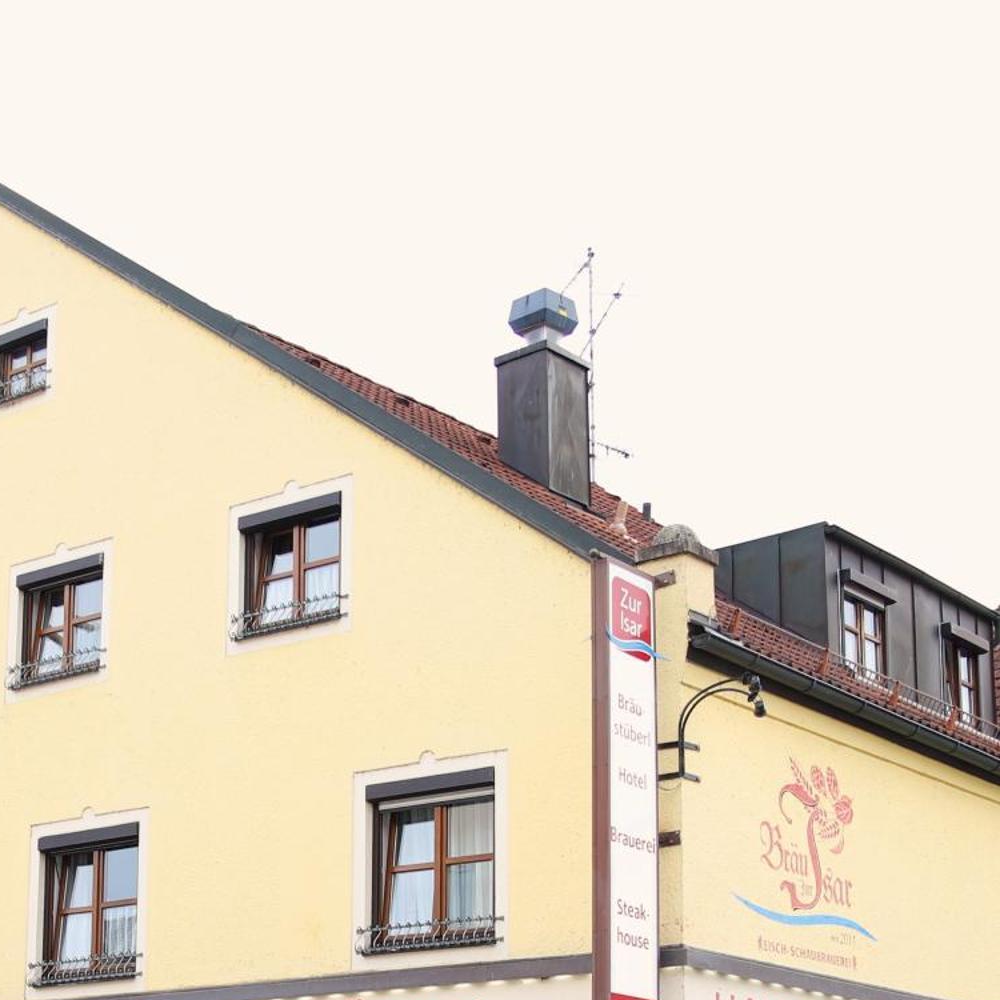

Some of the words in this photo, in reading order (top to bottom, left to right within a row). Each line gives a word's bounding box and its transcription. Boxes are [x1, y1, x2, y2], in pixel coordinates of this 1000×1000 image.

[620, 587, 642, 614] Zur
[621, 614, 644, 639] Isar
[614, 721, 651, 748] stüberl
[618, 767, 648, 790] Hotel
[610, 826, 656, 854] Brauerei
[759, 820, 808, 877] Bräu
[617, 898, 650, 921] Steak-
[617, 926, 650, 951] house
